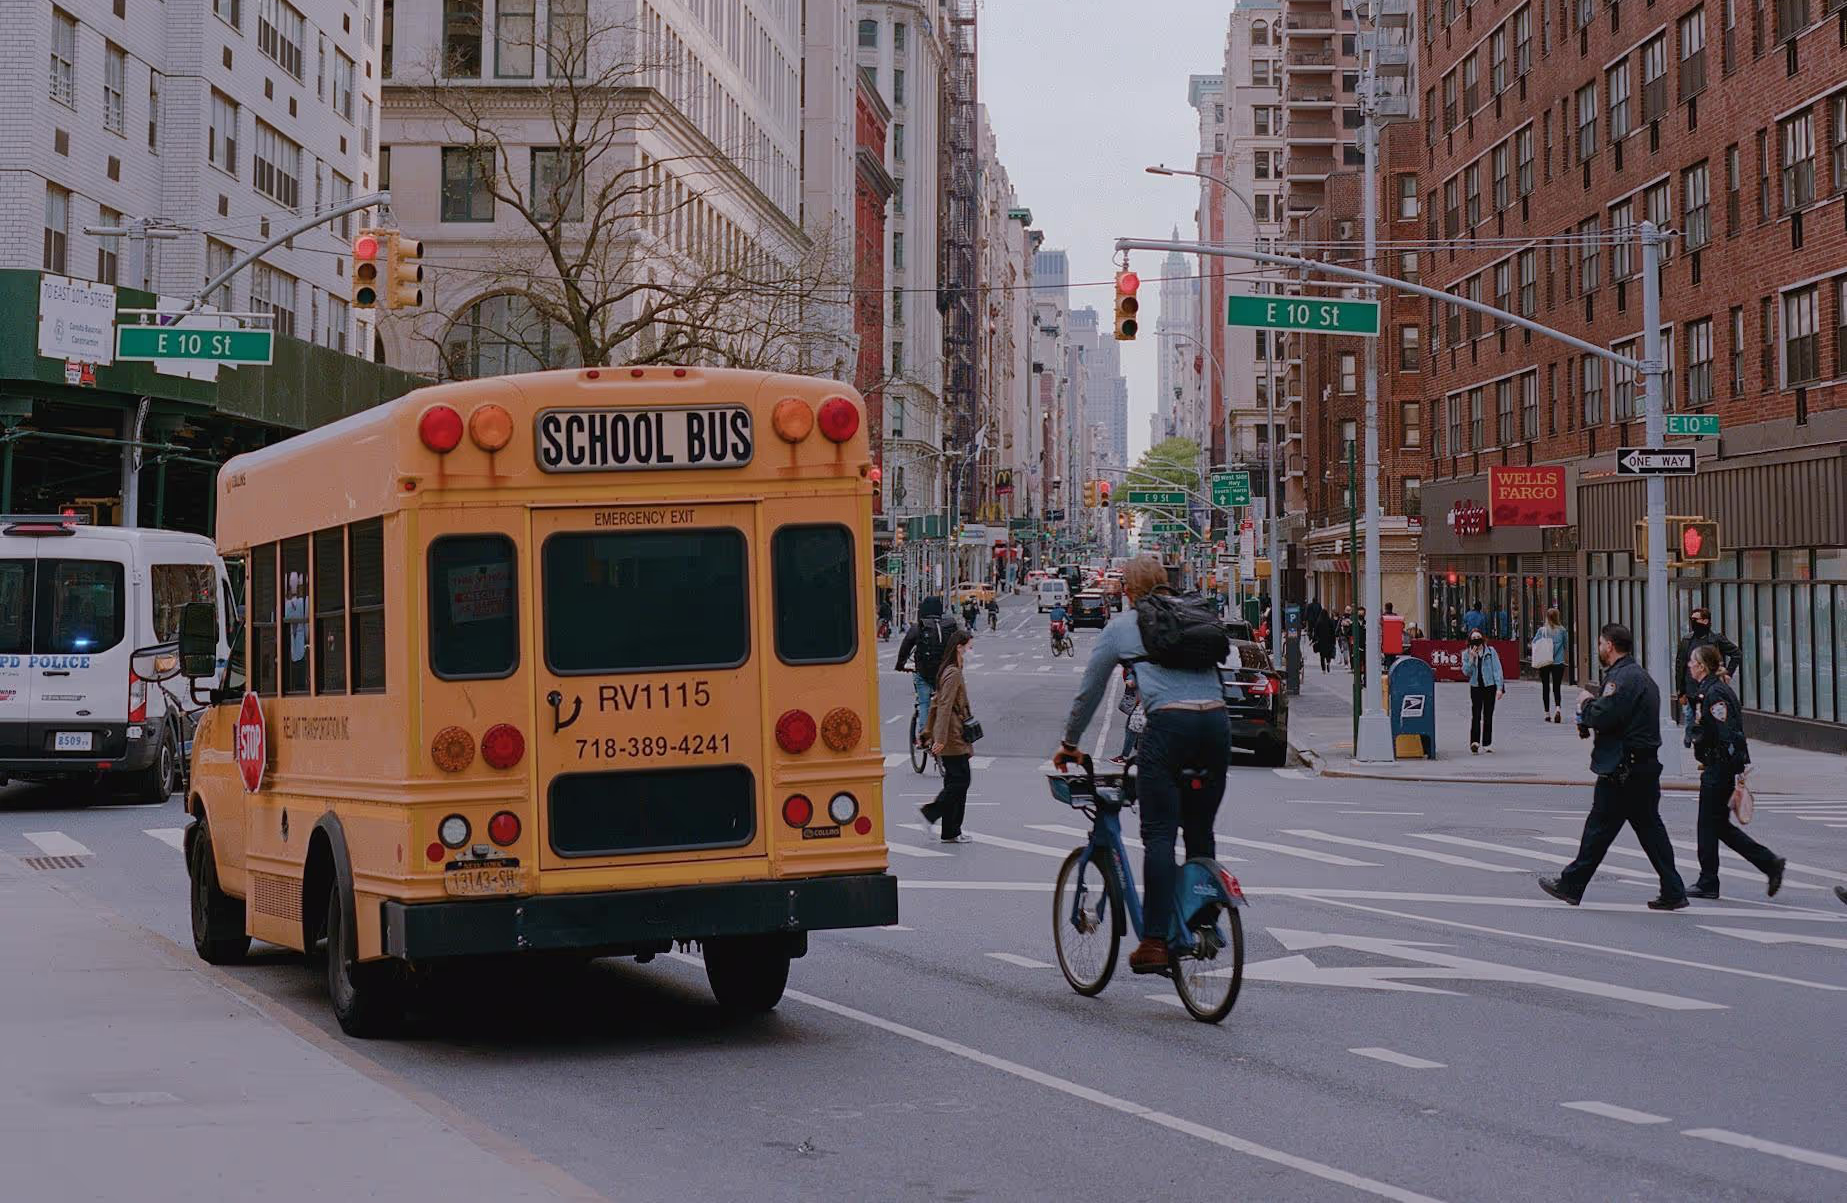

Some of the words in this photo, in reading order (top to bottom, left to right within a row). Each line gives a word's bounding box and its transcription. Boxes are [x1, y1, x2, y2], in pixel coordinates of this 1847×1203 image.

[1267, 302, 1276, 323] E
[1287, 303, 1310, 325] 10
[1319, 305, 1340, 327] St
[158, 334, 168, 354] E
[178, 334, 201, 355] 10
[211, 335, 232, 356] St
[1669, 417, 1679, 432] E
[1683, 417, 1700, 432] 10
[1703, 417, 1714, 426] ST
[542, 412, 674, 467] SCHOOL
[686, 410, 752, 464] BUS
[1629, 456, 1651, 467] ONE
[1662, 456, 1686, 467] WAY
[1497, 472, 1558, 485] WELLS
[1499, 487, 1558, 500] FARGO
[594, 510, 667, 526] EMERGENCY
[670, 509, 695, 524] EXIT
[28, 656, 91, 669] POLICE
[1432, 650, 1458, 664] the
[598, 681, 711, 712] RV1115
[240, 724, 261, 761] STOP
[576, 733, 730, 760] 718-389-4241
